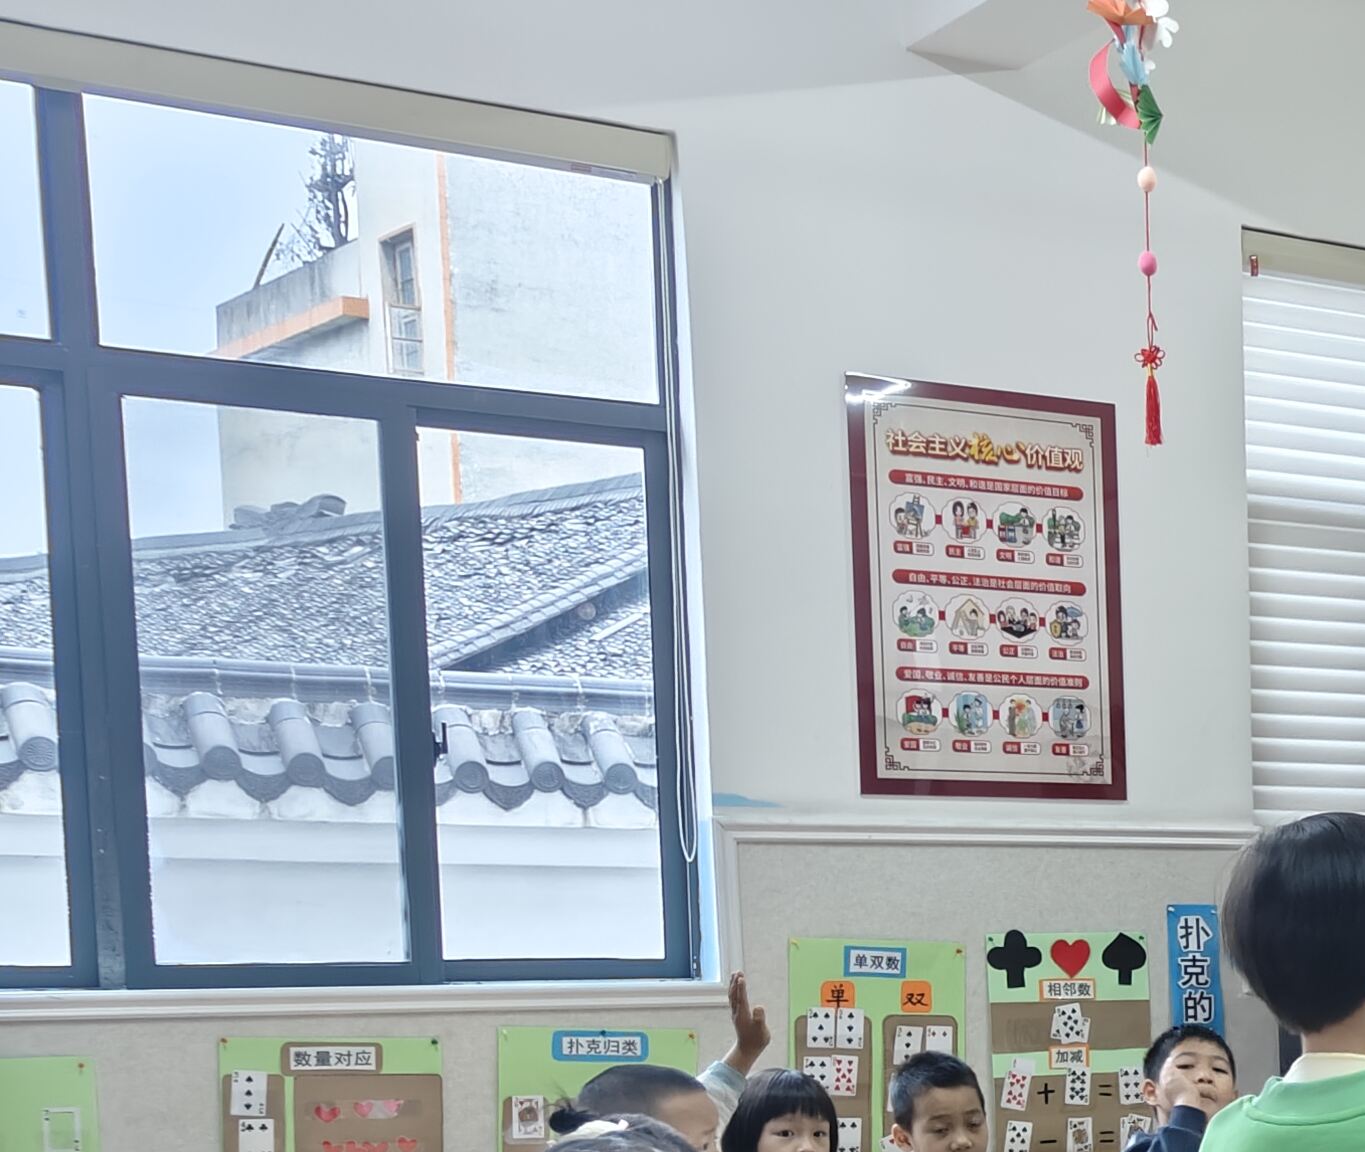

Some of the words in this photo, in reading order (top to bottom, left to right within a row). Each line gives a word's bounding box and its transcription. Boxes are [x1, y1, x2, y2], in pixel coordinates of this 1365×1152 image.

[885, 429, 1085, 472] 社会主义核心价值观
[853, 953, 900, 973] 单双数
[1177, 916, 1214, 1024] 扑克的
[825, 986, 850, 1008] 单
[1047, 981, 1092, 998] 相邻数
[903, 993, 928, 1007] 双
[567, 1038, 638, 1055] 扑克归类
[1055, 1050, 1084, 1063] 加减
[292, 1048, 373, 1068] 数量对应
